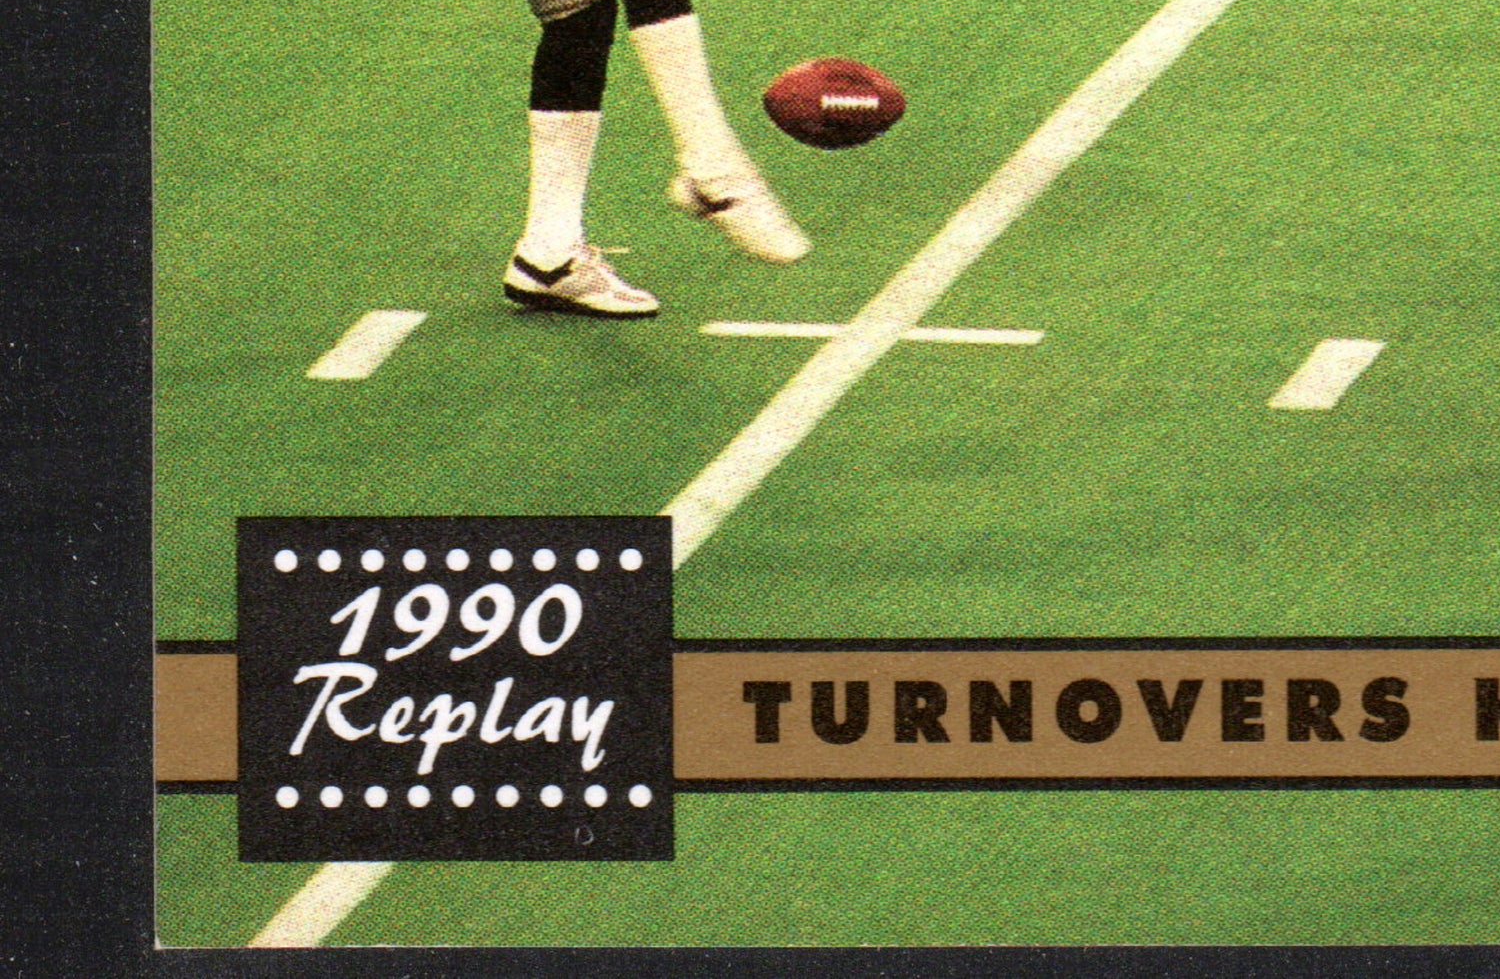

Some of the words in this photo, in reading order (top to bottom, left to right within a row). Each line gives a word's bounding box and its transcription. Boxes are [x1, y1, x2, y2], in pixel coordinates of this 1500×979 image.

[330, 583, 583, 661] 1990
[289, 662, 614, 775] Replay
[743, 677, 1410, 745] TURNOVERS
